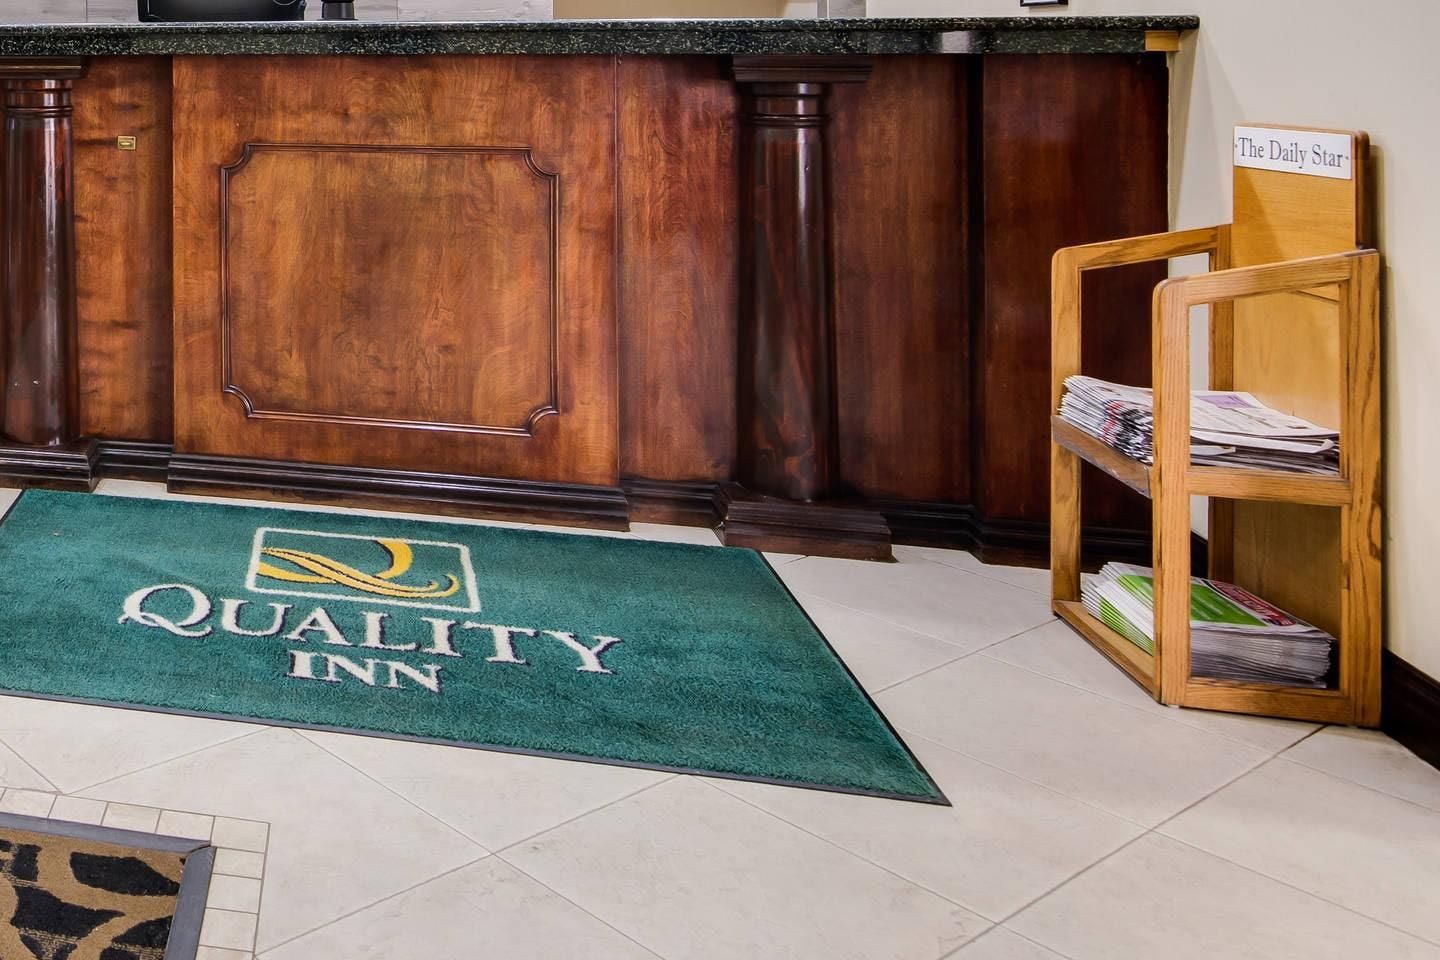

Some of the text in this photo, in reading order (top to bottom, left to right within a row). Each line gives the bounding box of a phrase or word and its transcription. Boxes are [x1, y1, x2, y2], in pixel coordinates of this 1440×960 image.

[1238, 137, 1343, 169] The Daily Star
[118, 583, 622, 675] QUALITY
[285, 650, 444, 694] INN
